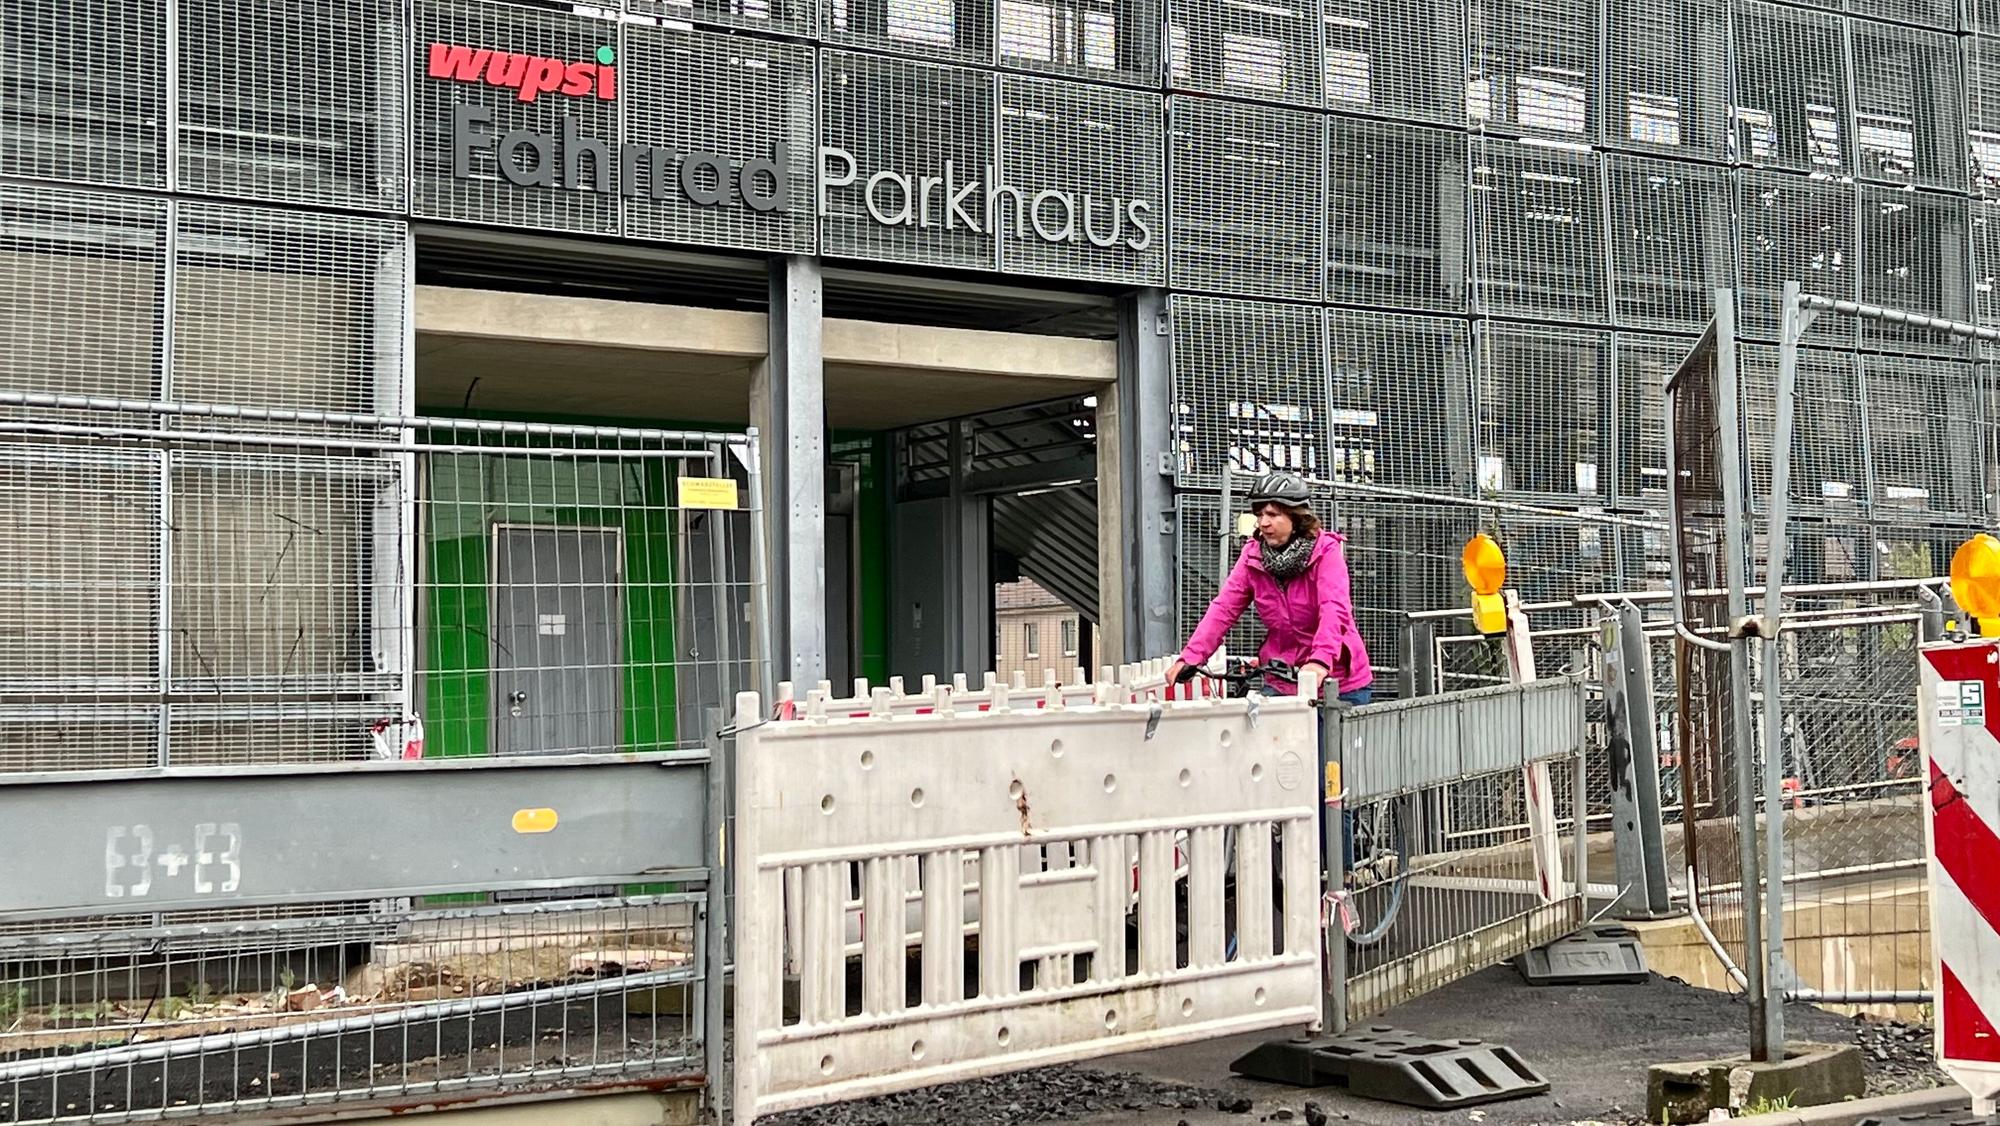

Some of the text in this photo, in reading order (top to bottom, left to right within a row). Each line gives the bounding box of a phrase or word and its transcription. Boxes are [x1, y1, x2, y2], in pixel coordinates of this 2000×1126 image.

[428, 43, 616, 103] wupsi
[453, 103, 1152, 251] Fahrrad Parkhaus
